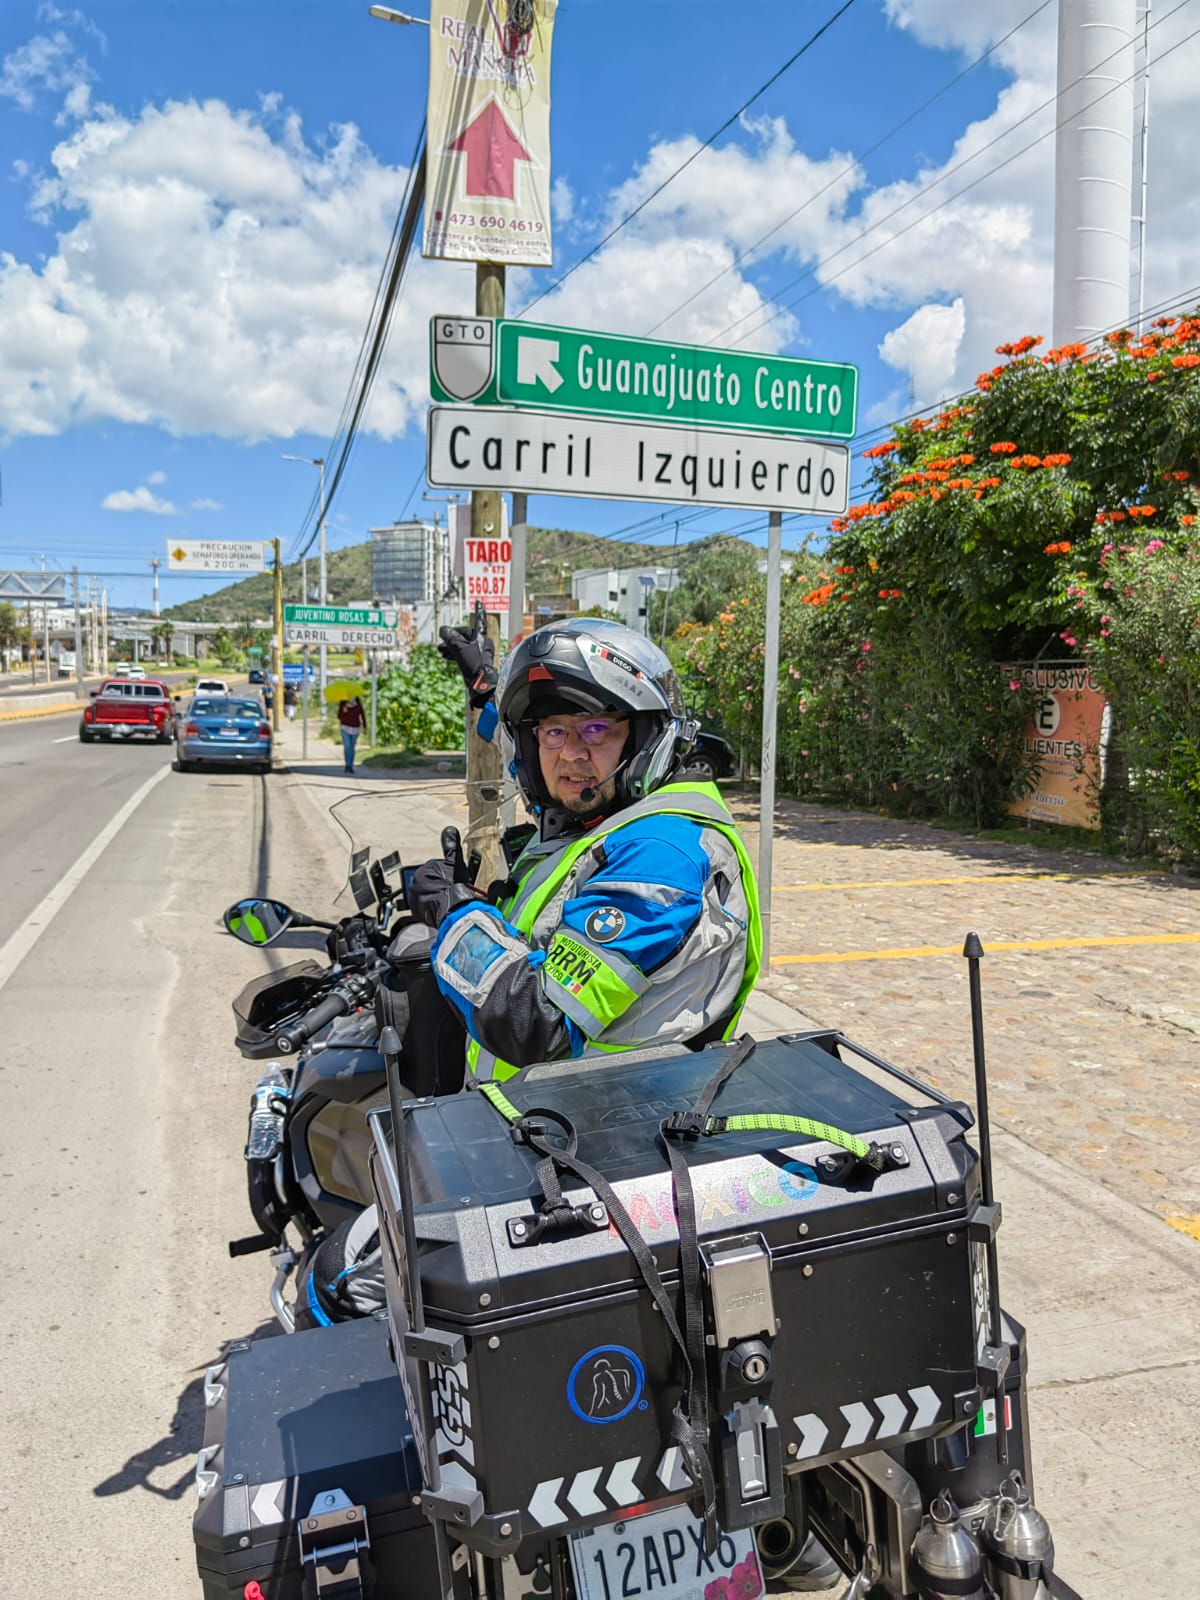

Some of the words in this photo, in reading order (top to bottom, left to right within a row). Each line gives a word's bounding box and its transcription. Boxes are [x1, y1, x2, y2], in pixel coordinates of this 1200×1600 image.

[449, 213, 476, 227] 473
[479, 216, 506, 230] 690
[509, 219, 544, 233] 4619
[442, 322, 486, 341] GTO
[576, 344, 742, 410] Guanajuato
[753, 366, 842, 417] Centro
[448, 425, 592, 479] Carril
[637, 440, 836, 497] Izquierdo
[200, 543, 253, 552] PRECAUCION
[294, 609, 336, 622] JUVENTINO
[338, 610, 365, 624] ROSAS
[287, 629, 330, 642] CARRIL
[341, 631, 394, 645] DERECHO
[1039, 699, 1055, 730] E
[1021, 739, 1083, 759] LIENTES
[598, 908, 623, 925] BMW
[560, 937, 602, 971] MOTOTURISTA
[592, 1519, 737, 1600] 12APX6
